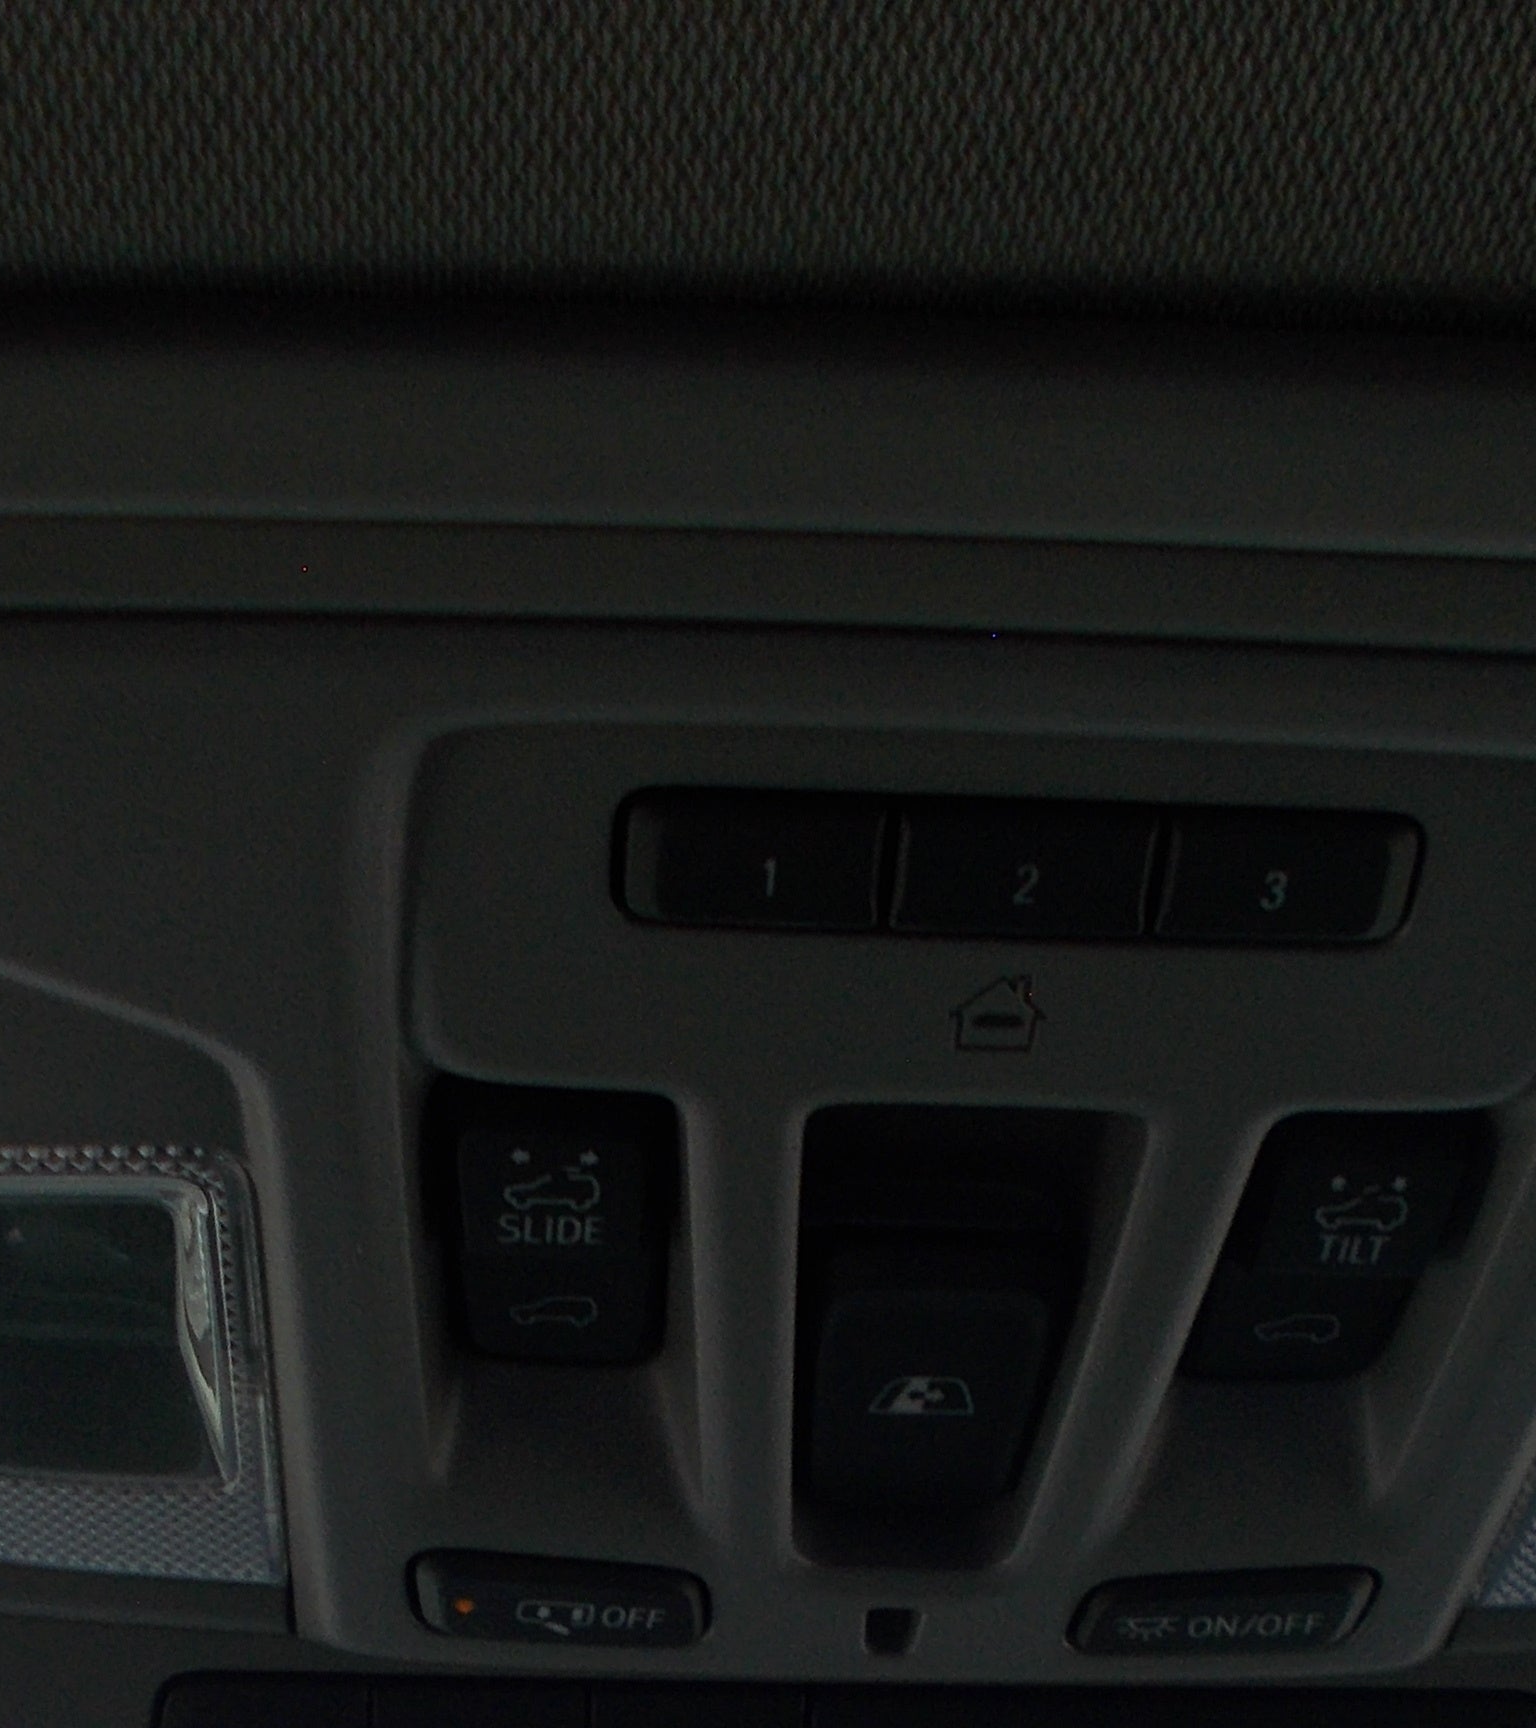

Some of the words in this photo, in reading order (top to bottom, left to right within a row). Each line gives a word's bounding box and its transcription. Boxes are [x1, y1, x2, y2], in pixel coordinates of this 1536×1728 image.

[763, 856, 777, 898] 1
[1012, 862, 1042, 908] 2
[1257, 868, 1289, 914] 3
[496, 1214, 605, 1247] SLIDE
[1317, 1232, 1393, 1266] TILT
[601, 1603, 666, 1631] OFF
[1185, 1613, 1326, 1640] ON/OFF
